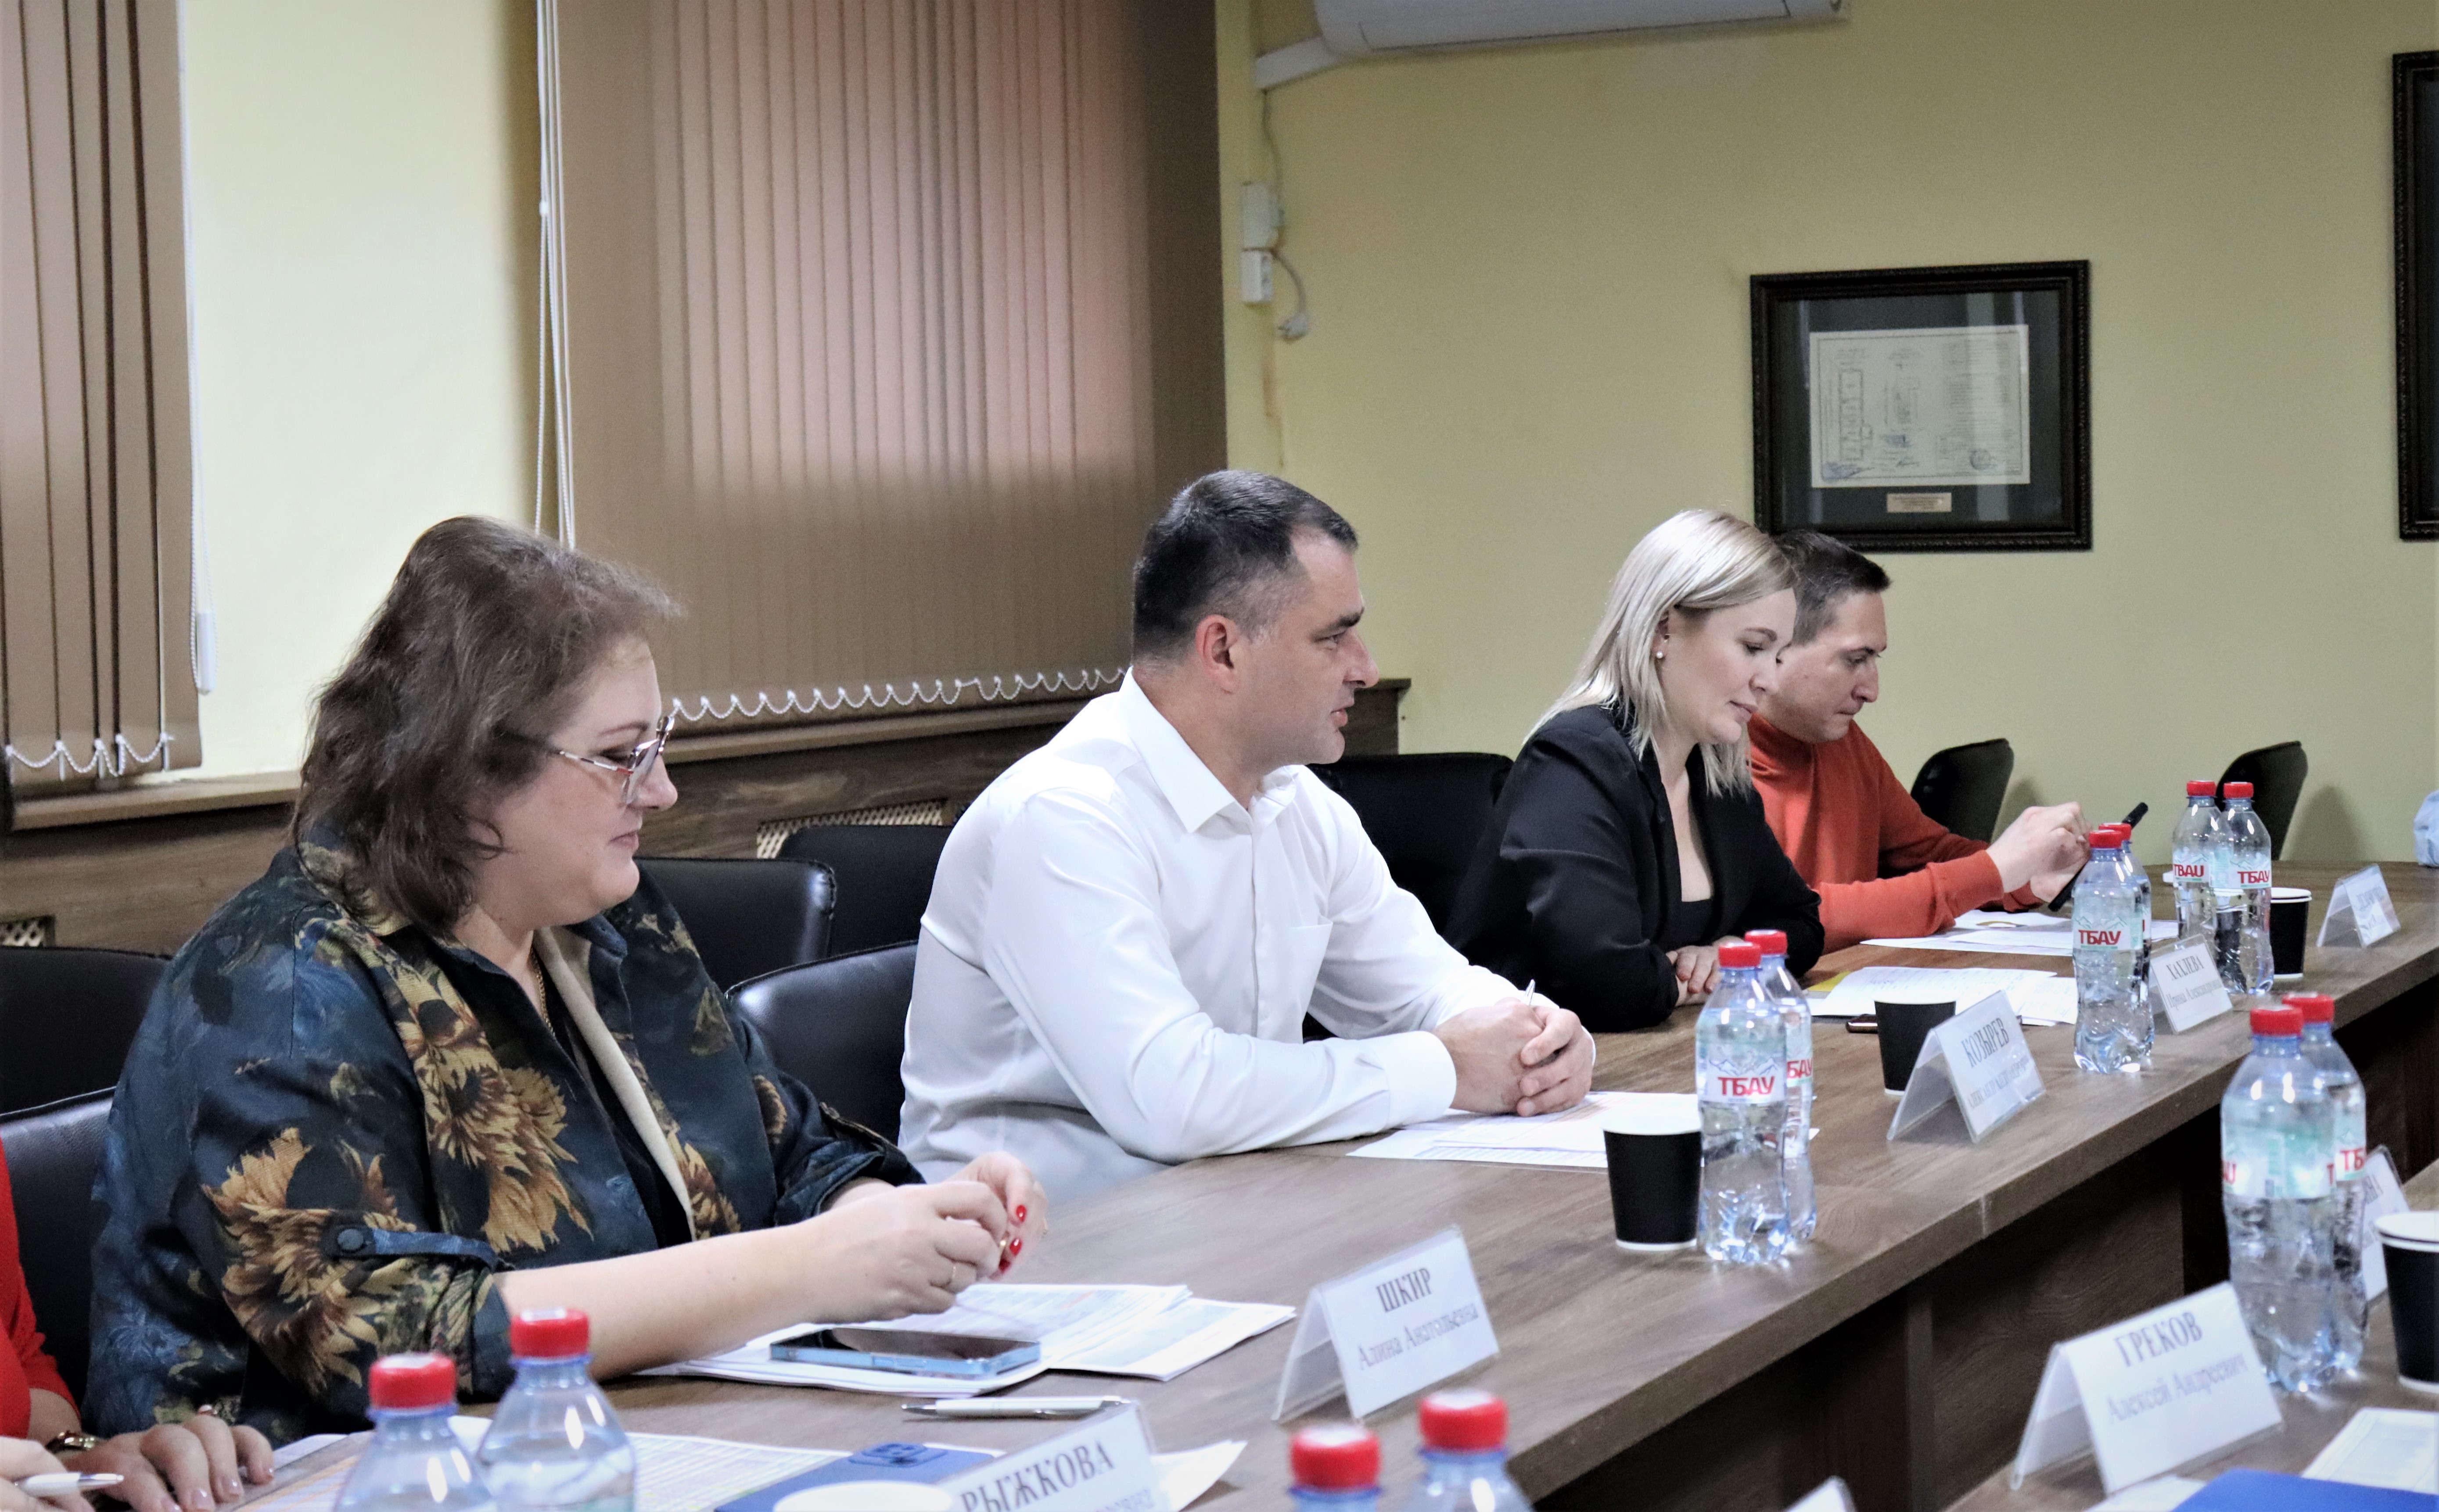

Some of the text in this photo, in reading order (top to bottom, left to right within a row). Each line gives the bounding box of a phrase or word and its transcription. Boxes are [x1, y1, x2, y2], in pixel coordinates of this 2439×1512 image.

[2078, 930, 2121, 945] ТБАУ
[2166, 955, 2204, 981] ХАХЛЕВА
[1961, 1018, 2009, 1068] КОЗЫРЕВ
[1718, 1076, 1775, 1096] ТБАУ
[1787, 1059, 1812, 1079] БАУ
[1376, 1268, 1432, 1312] ШКИР
[1358, 1303, 1479, 1370] Алина Анатольевна
[2114, 1311, 2203, 1367] ГРЕКОВ
[2107, 1376, 2172, 1426] Алексей
[960, 1440, 1115, 1512] РЫЖКОВА
